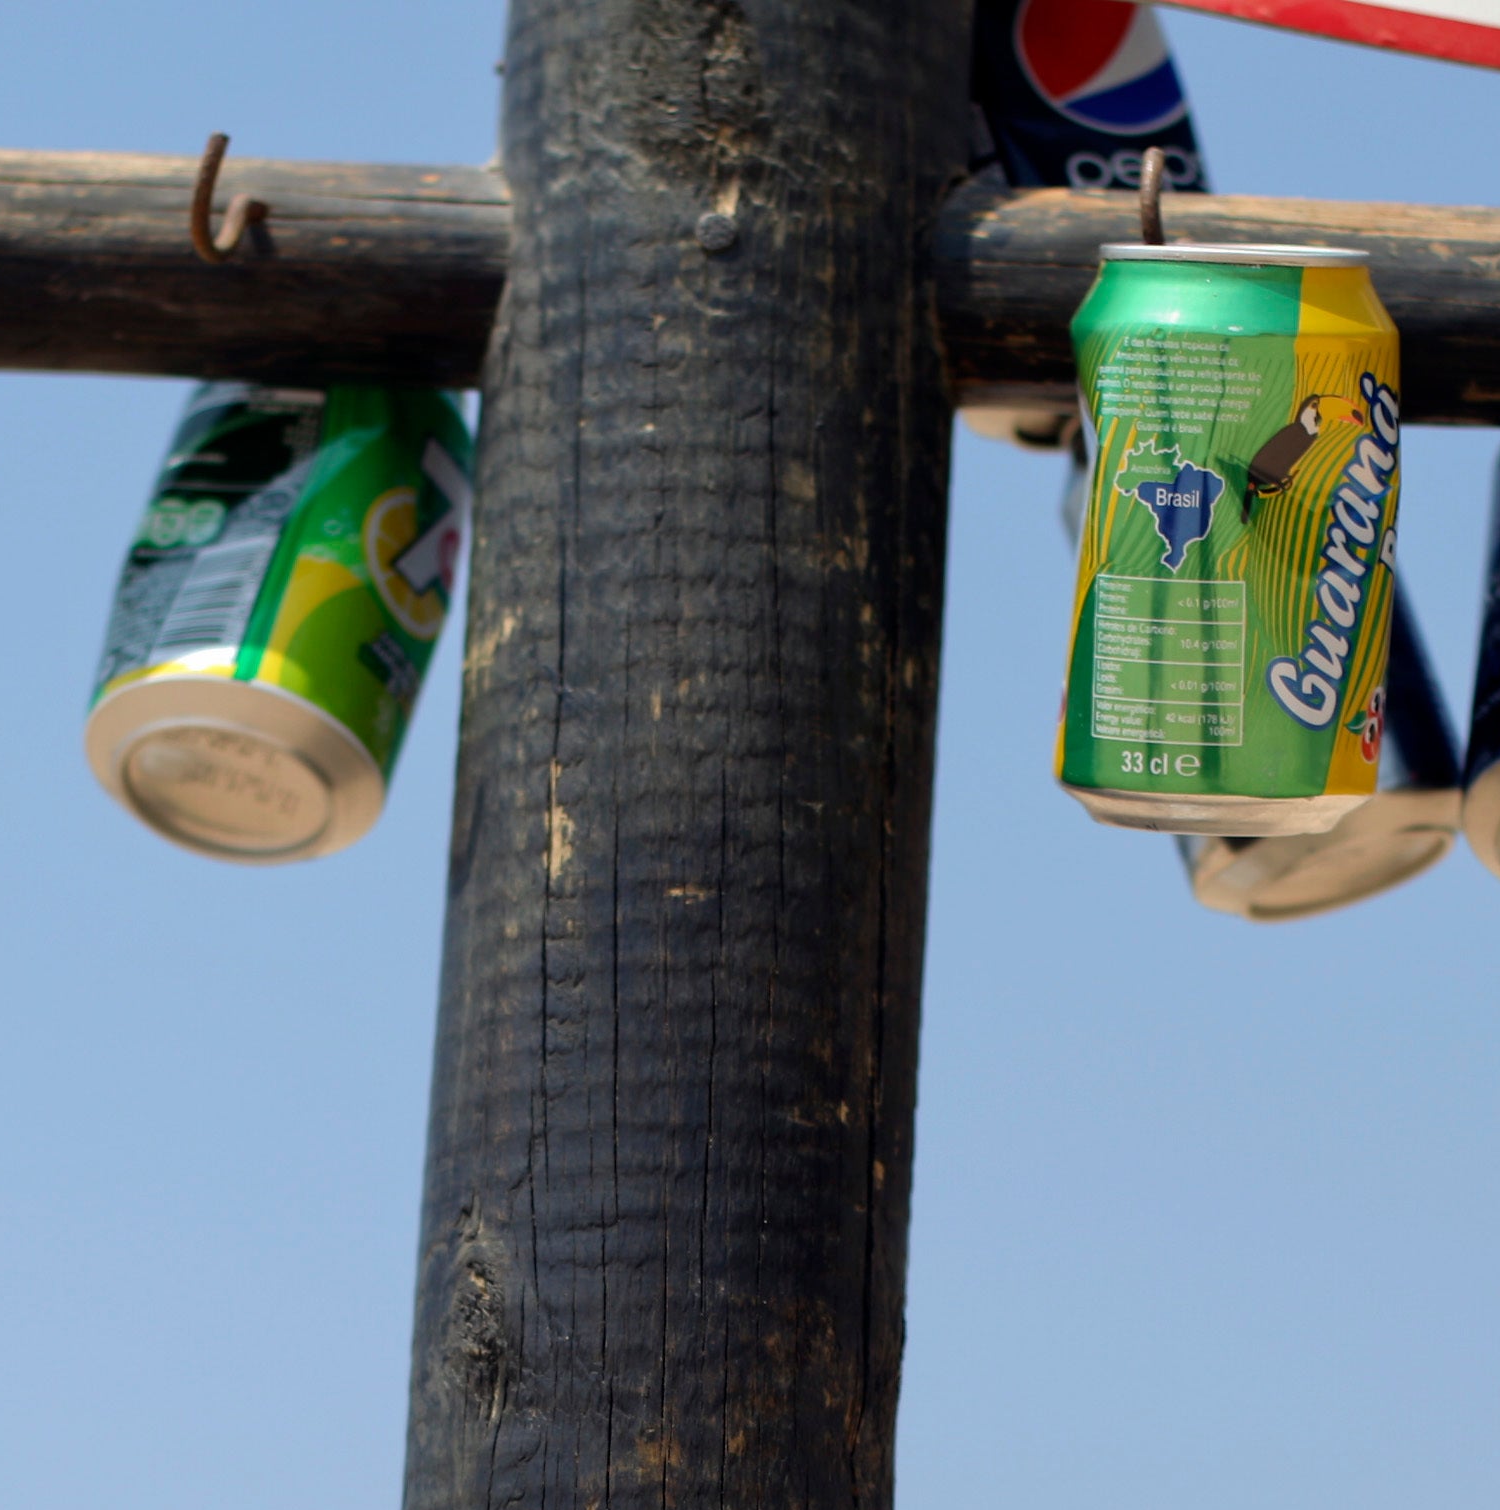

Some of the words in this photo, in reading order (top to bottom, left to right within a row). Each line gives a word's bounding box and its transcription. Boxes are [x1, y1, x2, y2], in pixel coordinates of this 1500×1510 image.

[1155, 488, 1201, 508] Brasil
[1269, 374, 1399, 727] Guaraná
[1121, 751, 1143, 773] 33
[1150, 752, 1168, 775] cl
